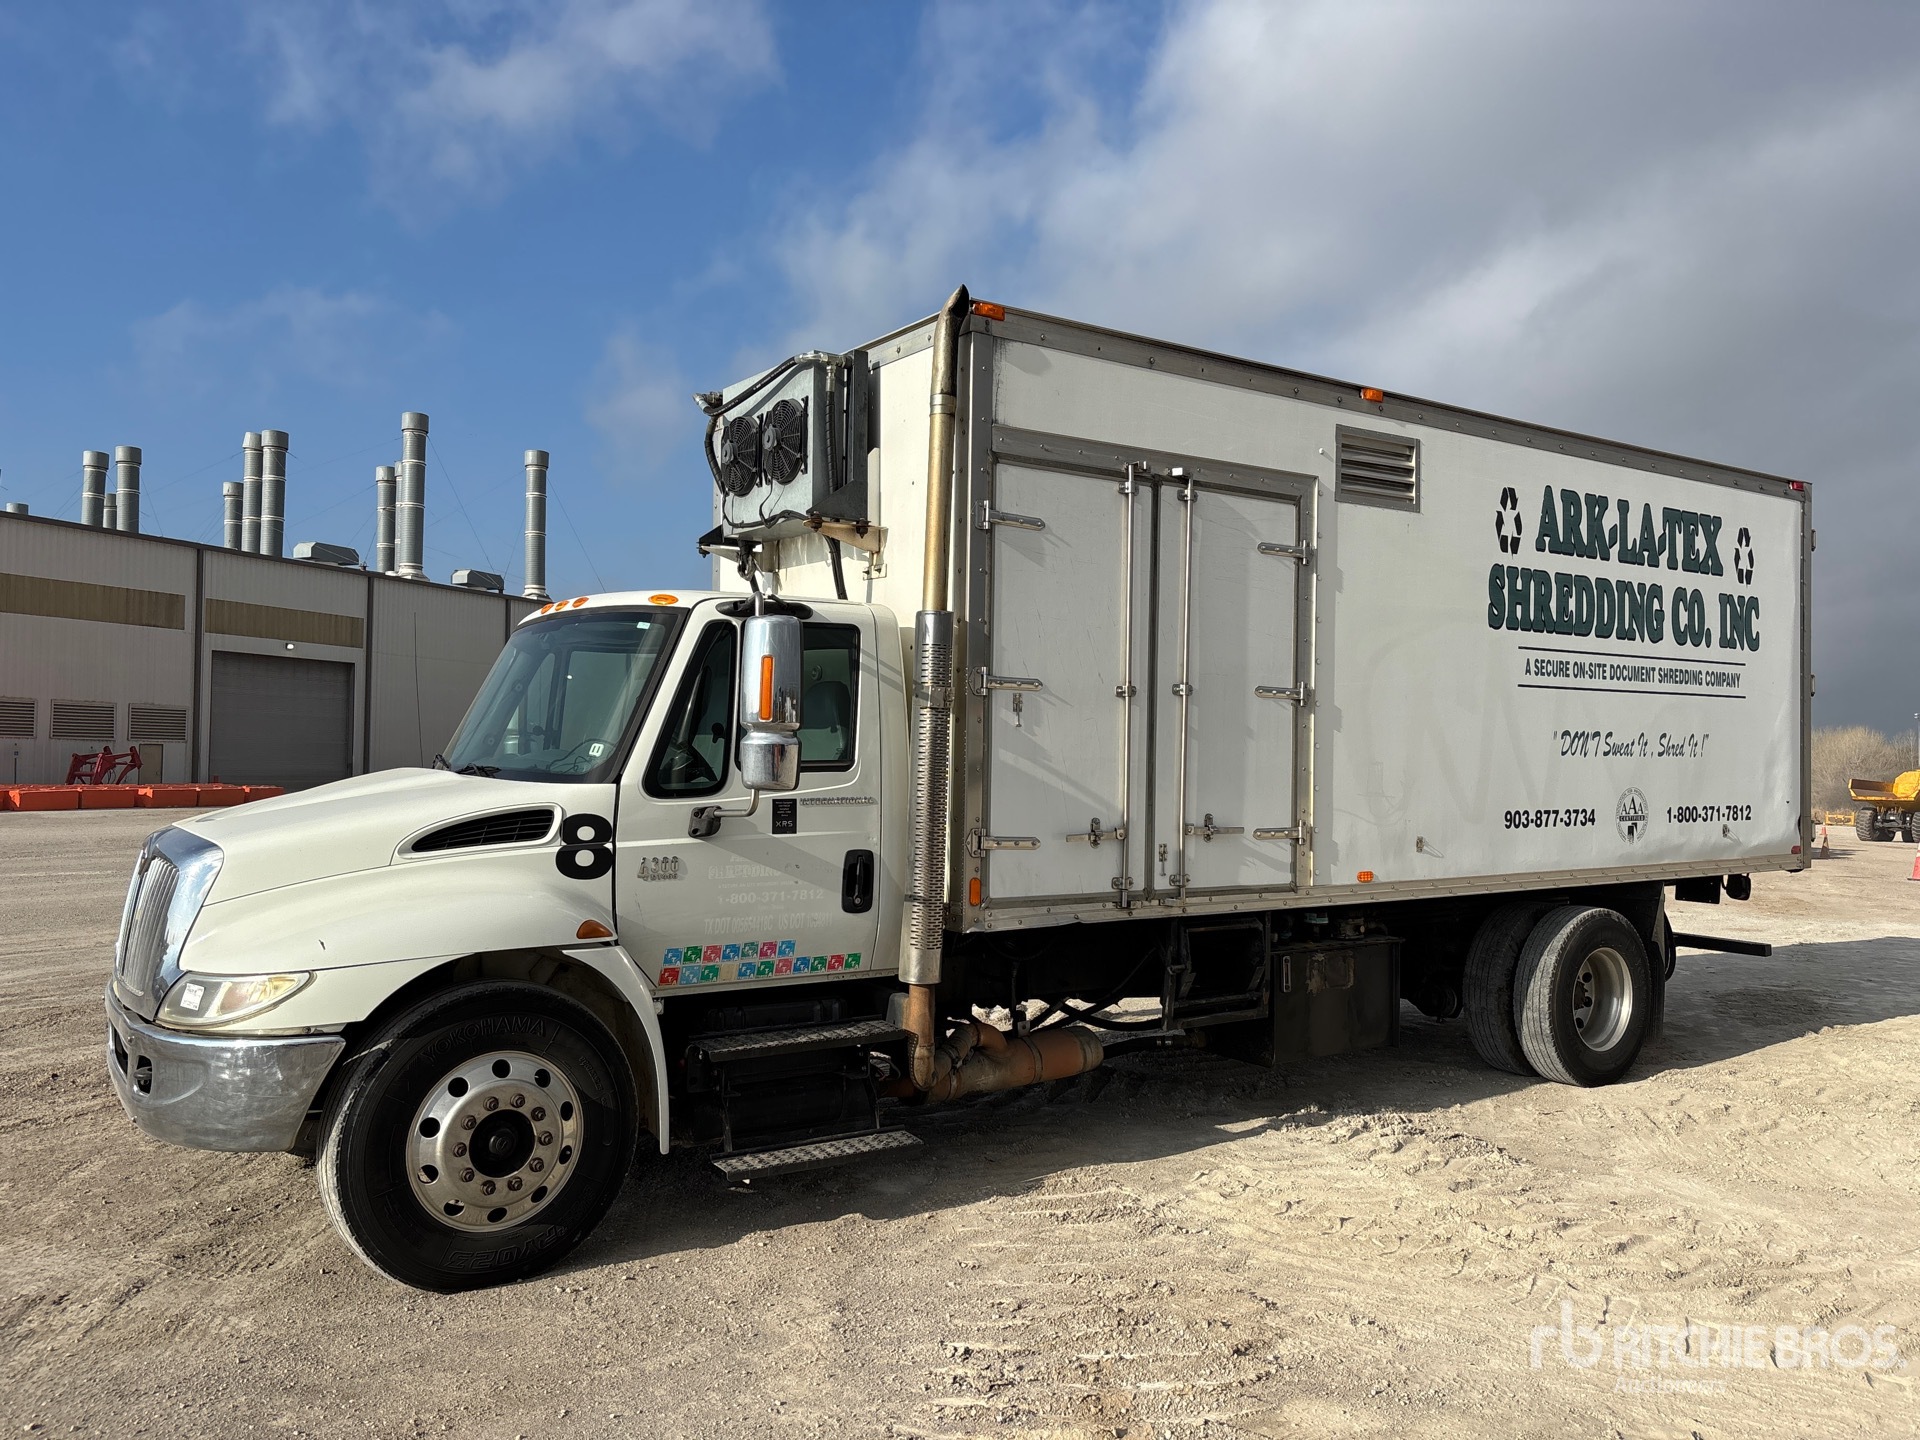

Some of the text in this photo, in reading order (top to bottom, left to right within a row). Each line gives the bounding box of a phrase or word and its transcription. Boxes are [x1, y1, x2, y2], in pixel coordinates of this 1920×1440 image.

[1488, 564, 1760, 651] SHREDDING CO. INC
[1525, 658, 1741, 689] A SECURE ON-SITE DOCUMENT SHREDDING COMPANY
[1603, 731, 1635, 758] Sweat
[1657, 732, 1686, 758] Shred
[775, 820, 793, 828] XRS
[1504, 808, 1596, 829] 903-877-3734
[1666, 805, 1752, 823] 1-800-371-7812
[556, 813, 613, 880] 8
[717, 889, 825, 905] 1-800-371-7812
[420, 1015, 547, 1063] YOKOHAMA
